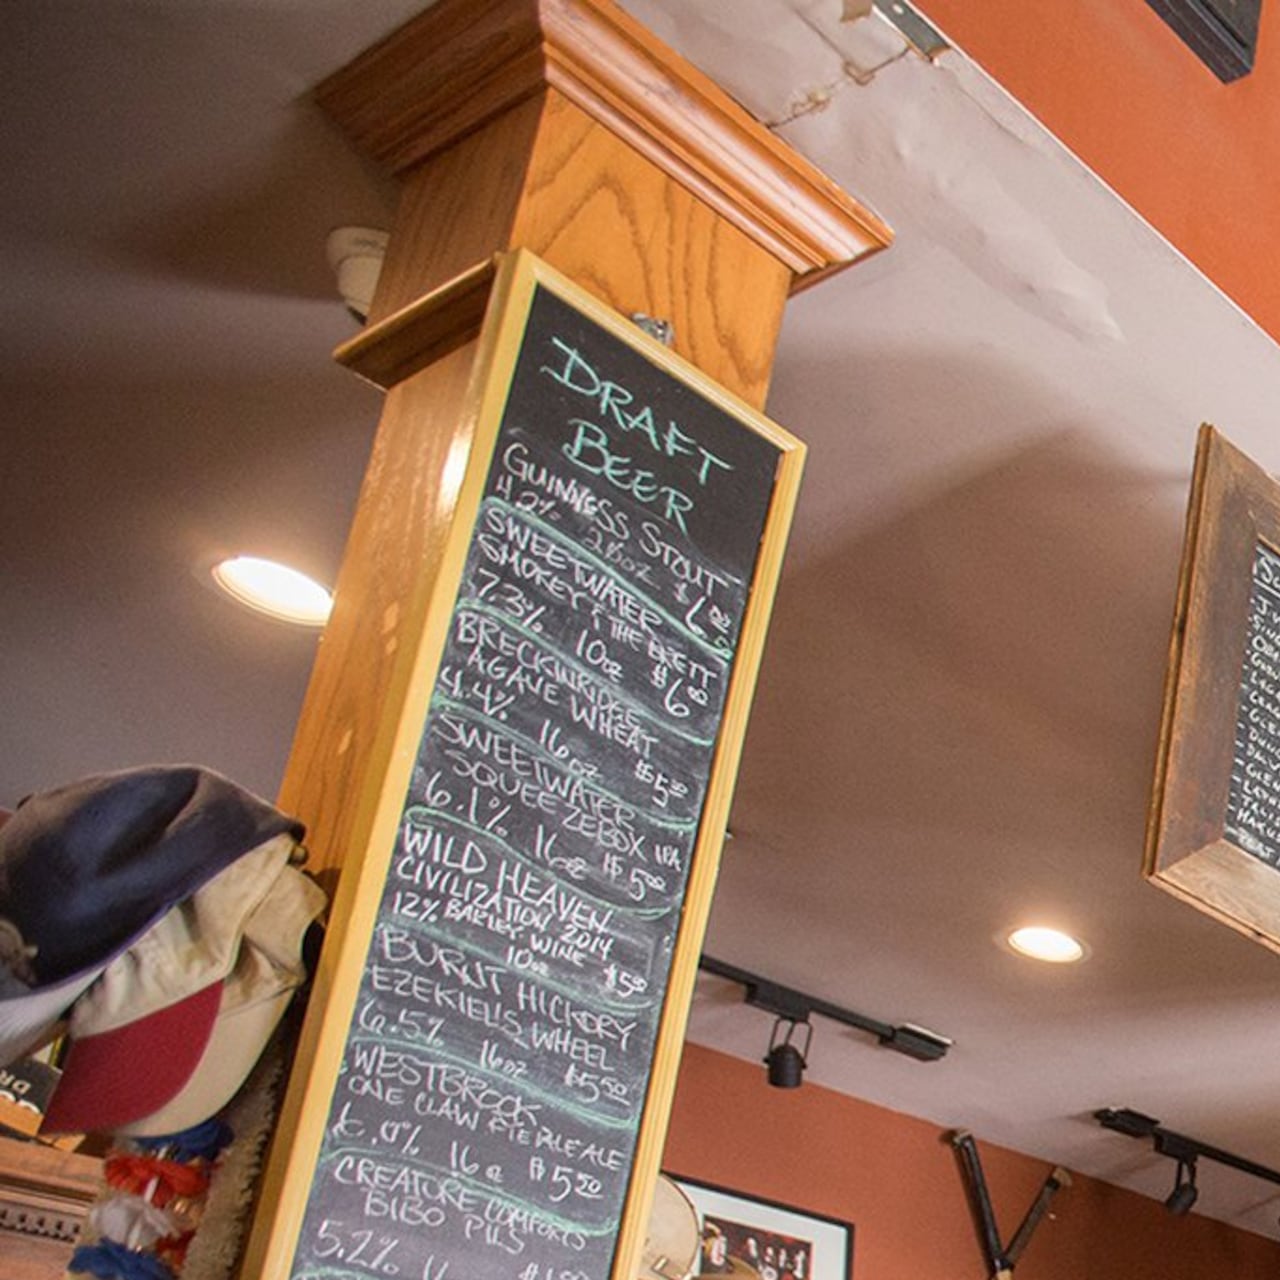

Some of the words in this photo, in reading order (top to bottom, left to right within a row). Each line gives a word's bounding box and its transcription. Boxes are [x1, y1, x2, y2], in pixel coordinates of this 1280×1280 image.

[540, 336, 735, 486] DRAFT
[562, 418, 693, 535] BEER
[572, 695, 659, 758] WHEAT
[404, 823, 488, 873] WILD
[560, 924, 614, 962] 2014
